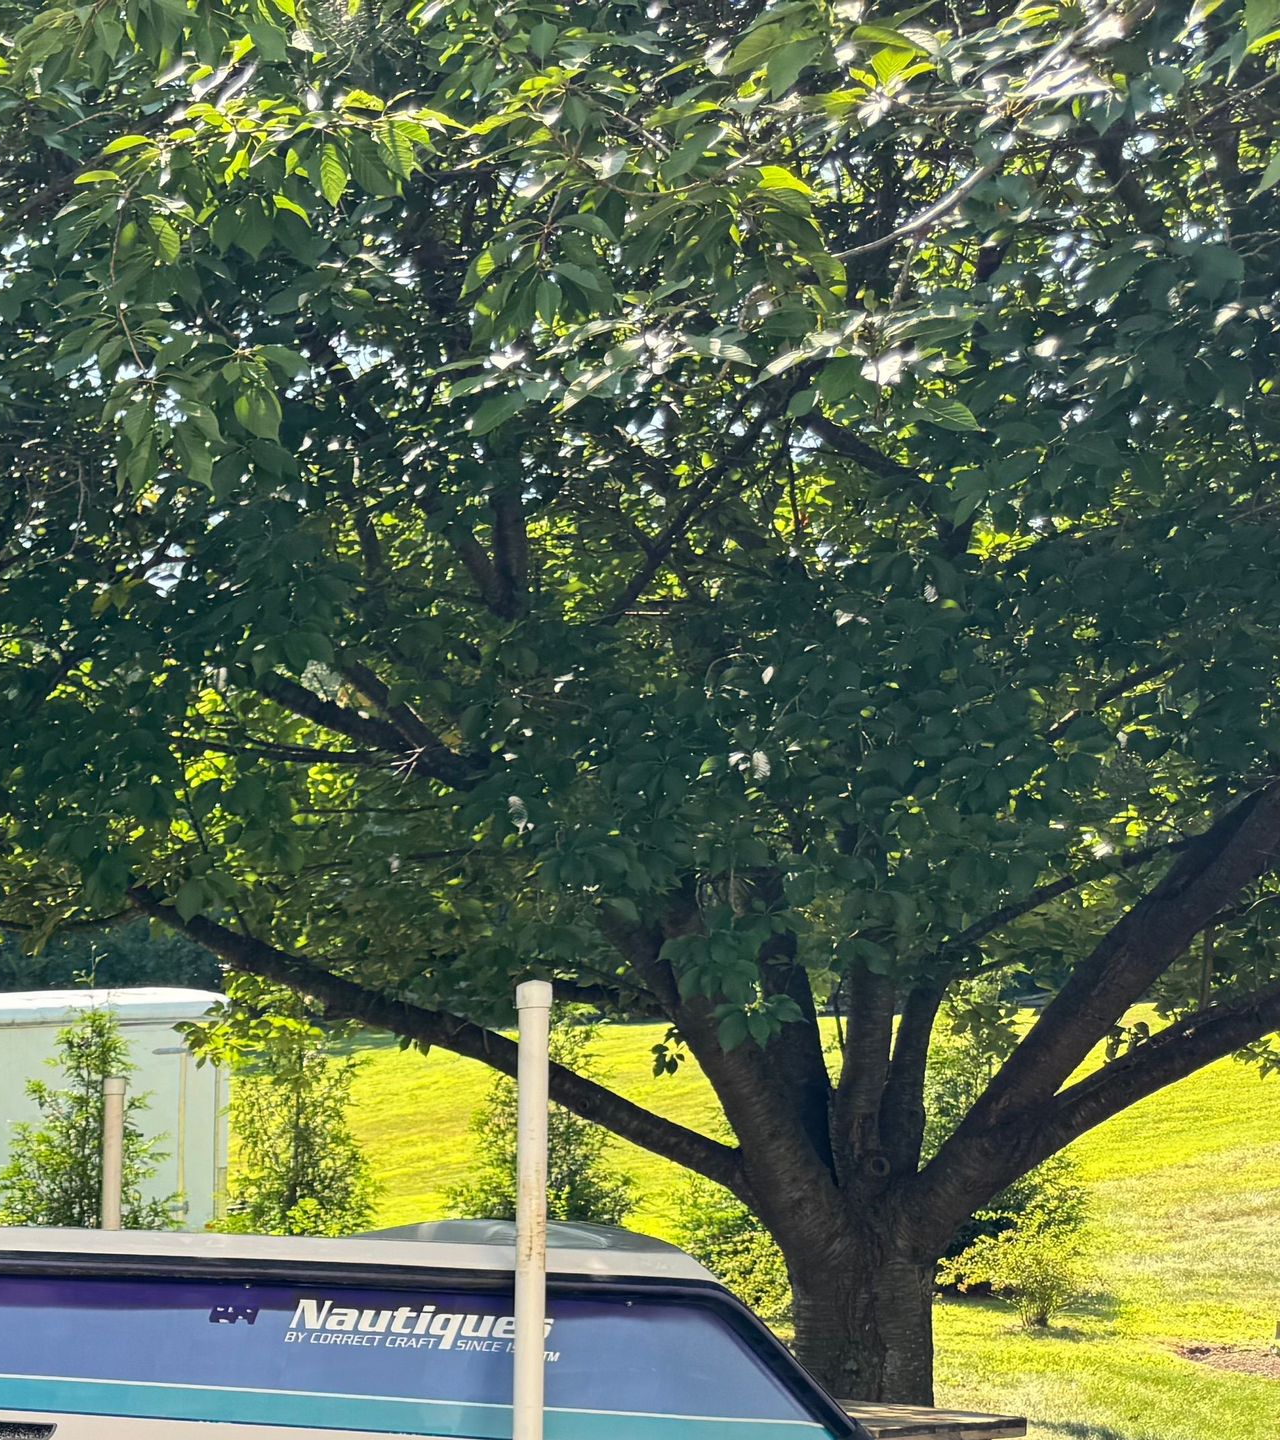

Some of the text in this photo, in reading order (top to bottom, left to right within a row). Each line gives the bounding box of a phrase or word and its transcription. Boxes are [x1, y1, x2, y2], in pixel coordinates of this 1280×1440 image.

[284, 1331, 308, 1344] BY
[309, 1332, 383, 1347] CORRECT
[385, 1336, 438, 1350] CRAFT
[455, 1339, 503, 1353] SINCE
